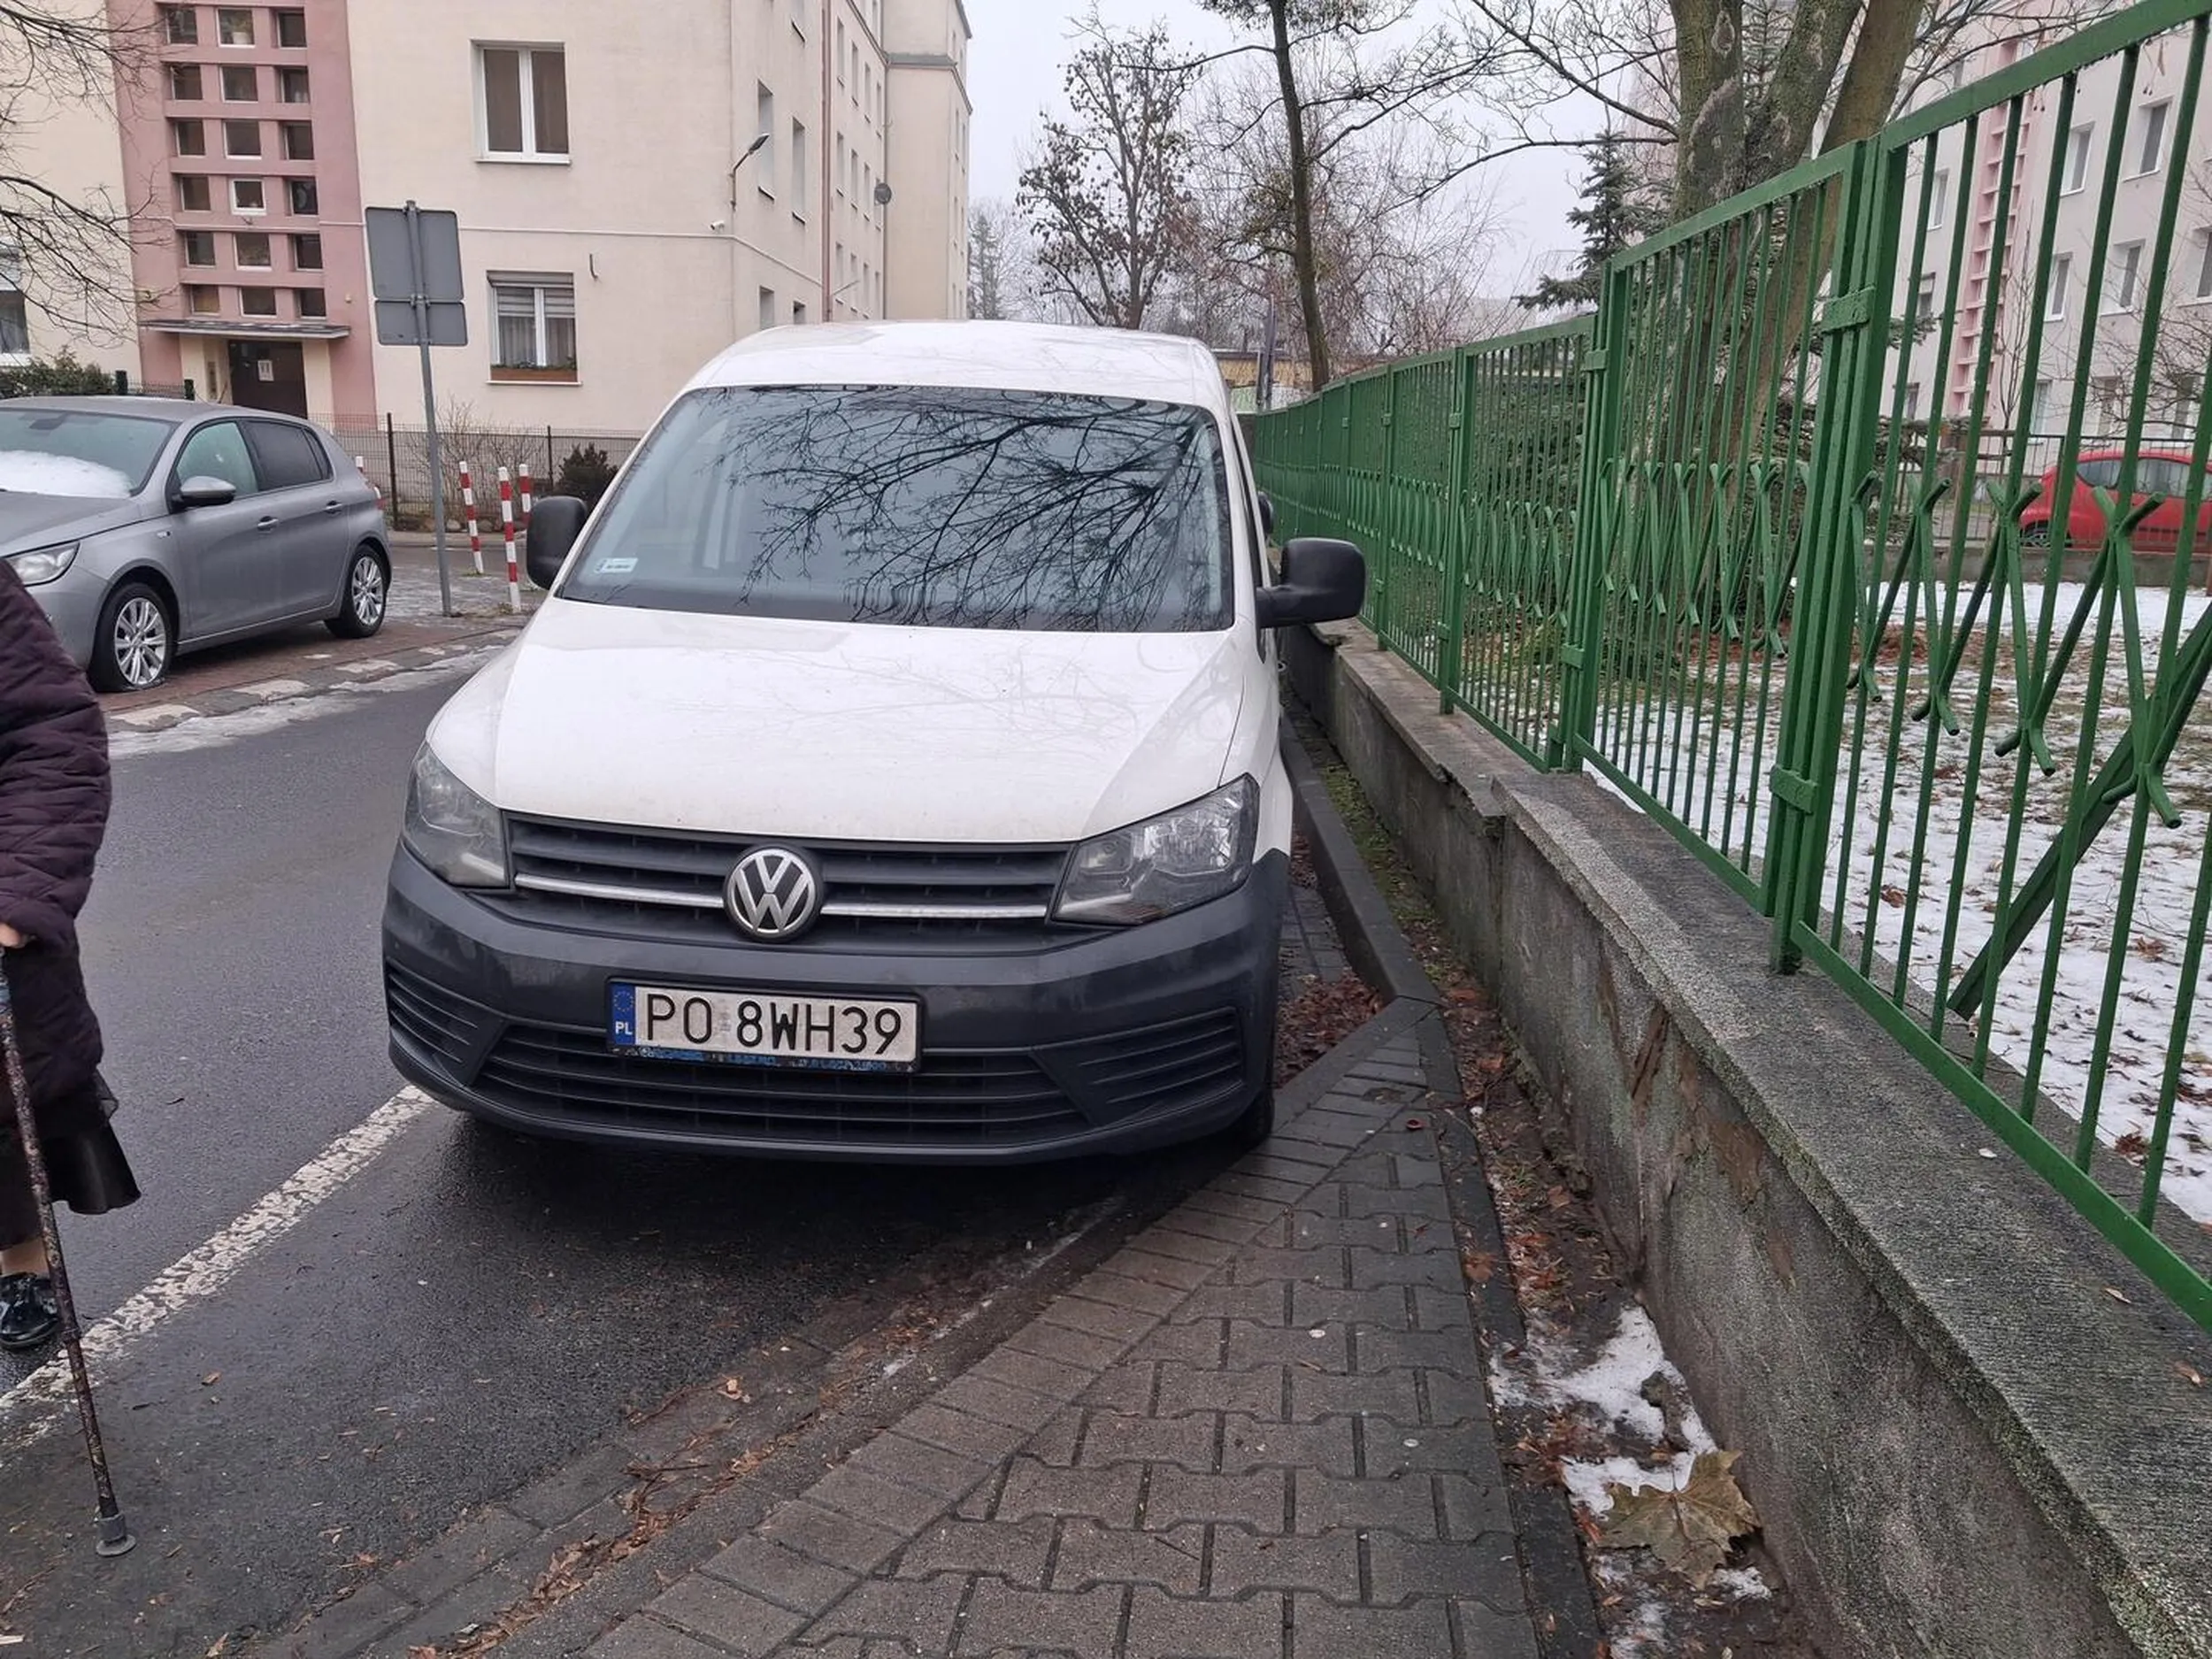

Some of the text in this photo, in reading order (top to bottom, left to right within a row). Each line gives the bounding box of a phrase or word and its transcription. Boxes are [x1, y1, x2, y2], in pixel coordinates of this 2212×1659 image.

[727, 849, 816, 938] VW
[615, 1020, 634, 1036] PL
[647, 994, 902, 1055] PO 8WH39
